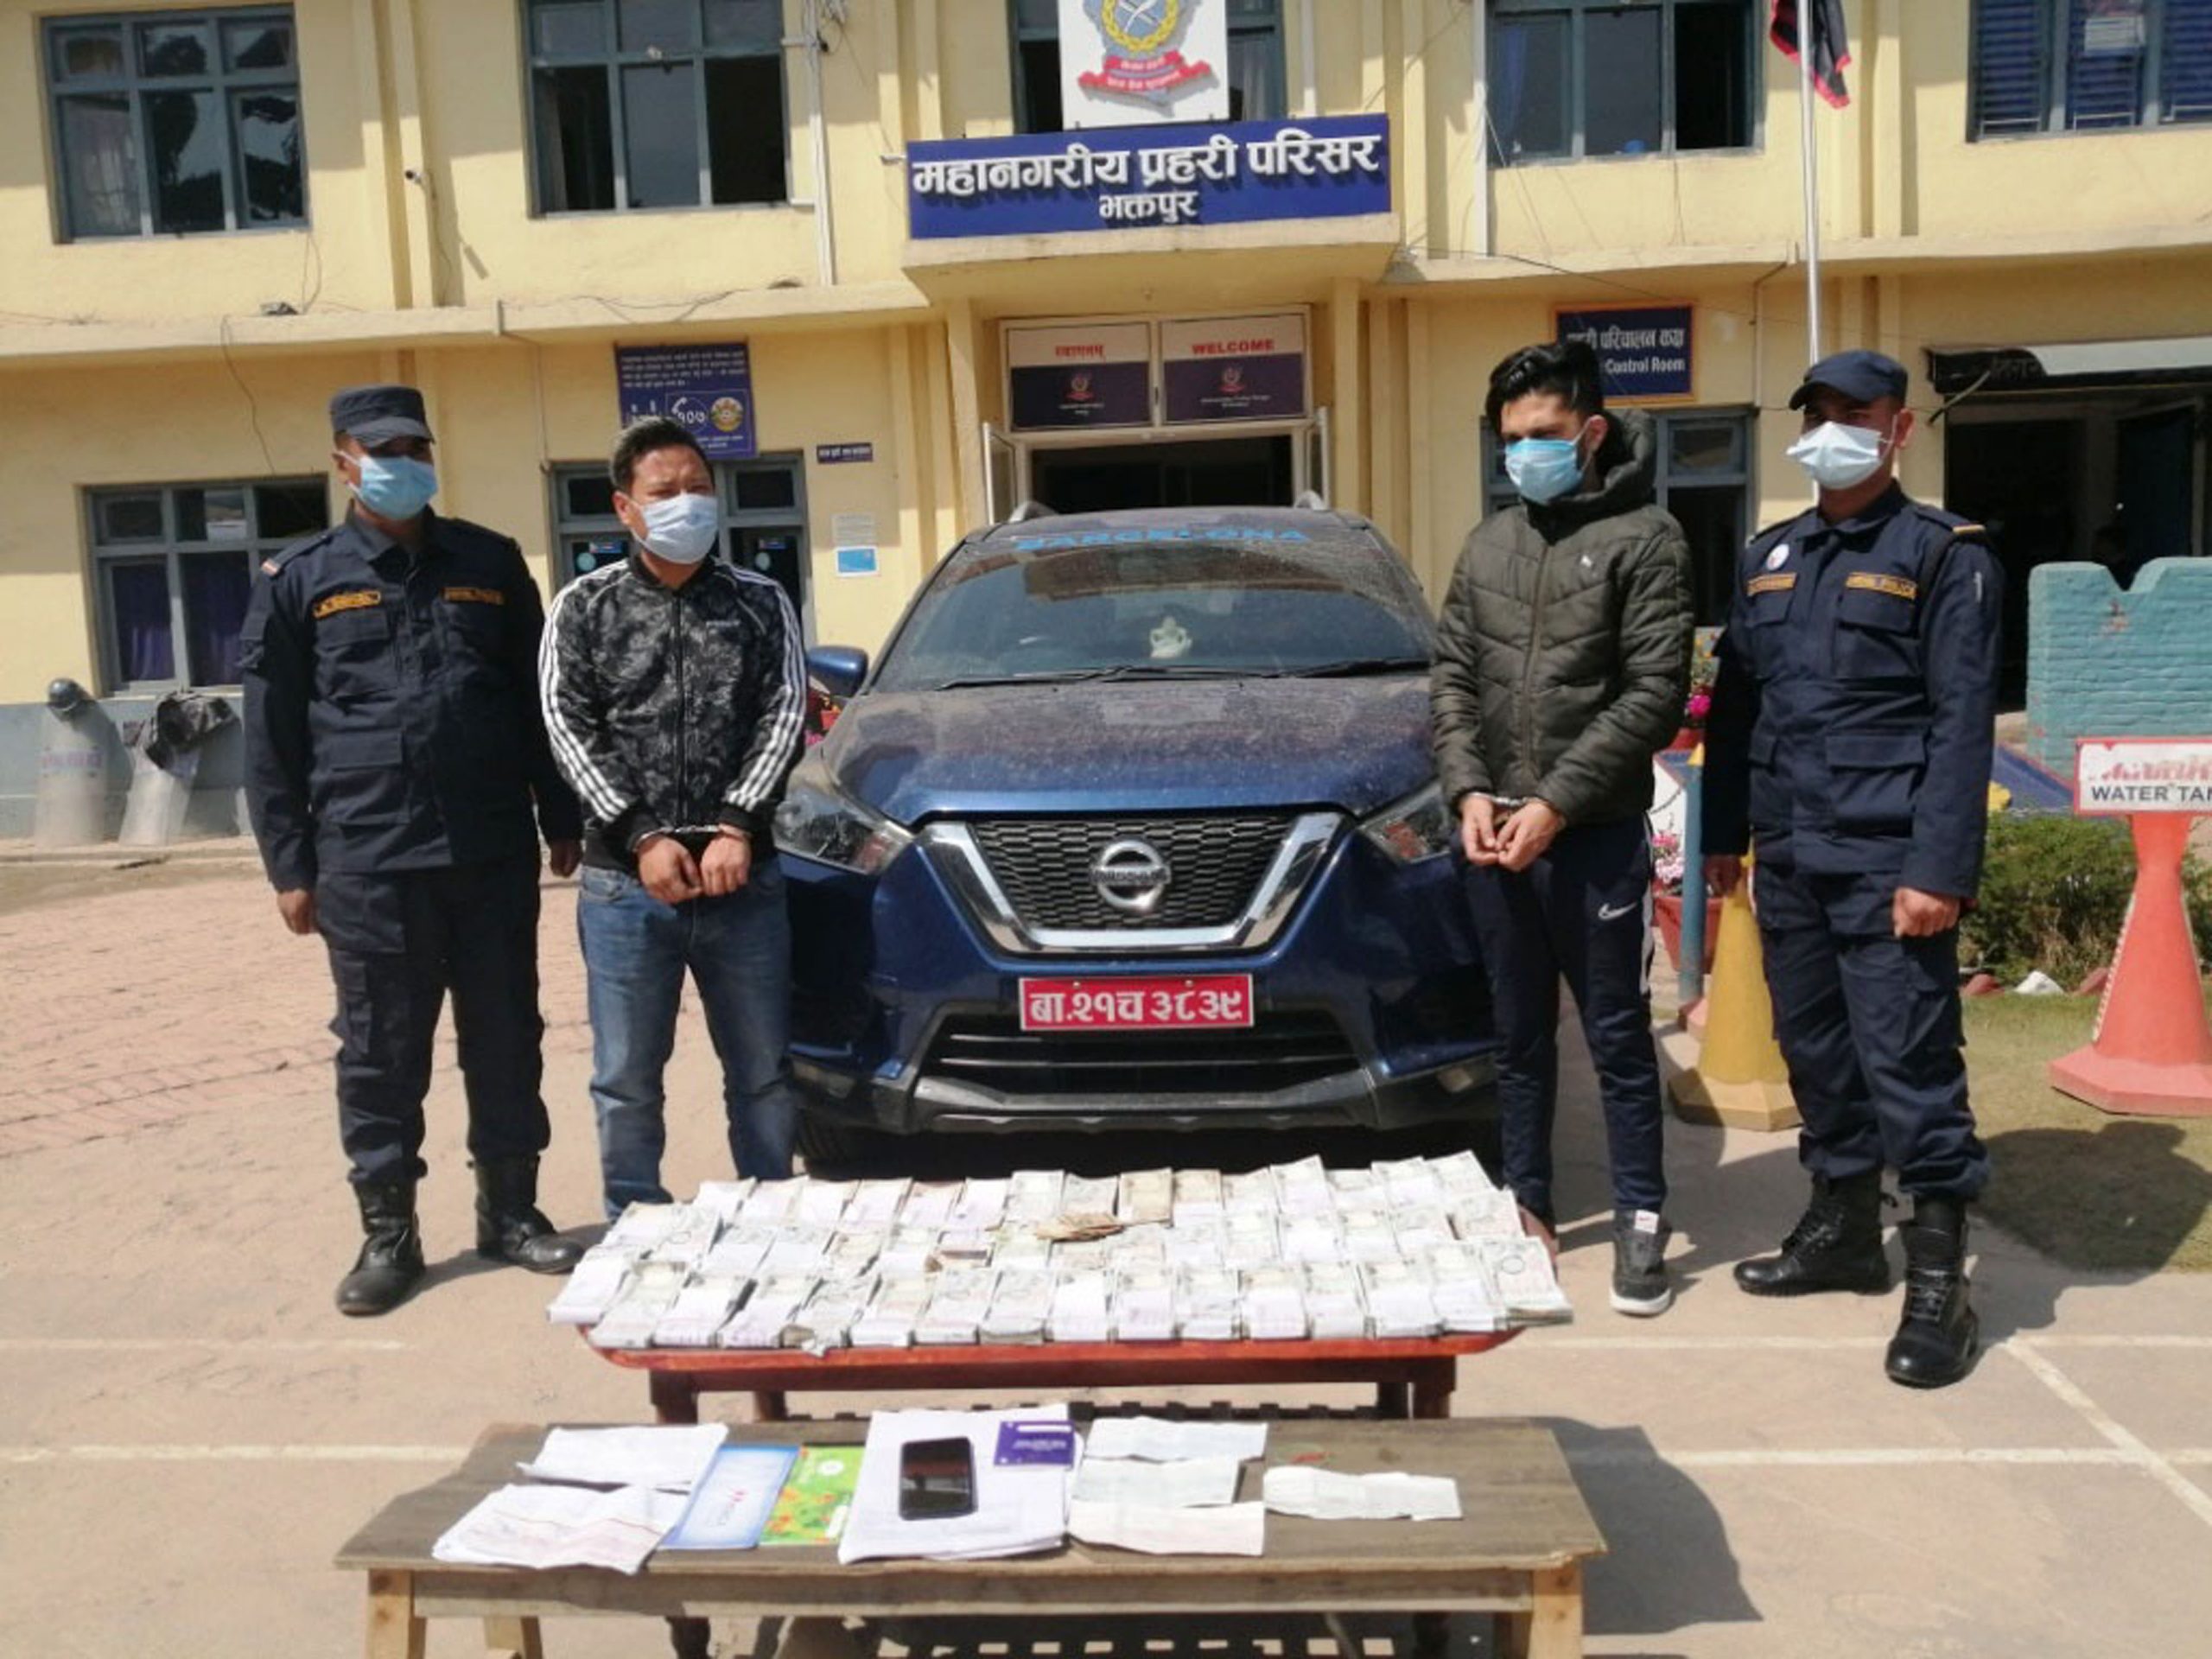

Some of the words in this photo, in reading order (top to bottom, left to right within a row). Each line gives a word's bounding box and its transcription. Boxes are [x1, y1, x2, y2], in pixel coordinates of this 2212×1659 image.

[912, 142, 1130, 195] महानगरीय
[1138, 134, 1238, 188] प्रहरी
[1247, 129, 1382, 175] परिसर
[1098, 189, 1198, 222] भक्तपुर
[1192, 340, 1275, 354] WELCOME
[1605, 357, 1649, 374] Control
[1651, 356, 1685, 372] Room
[2092, 785, 2168, 801] WATER
